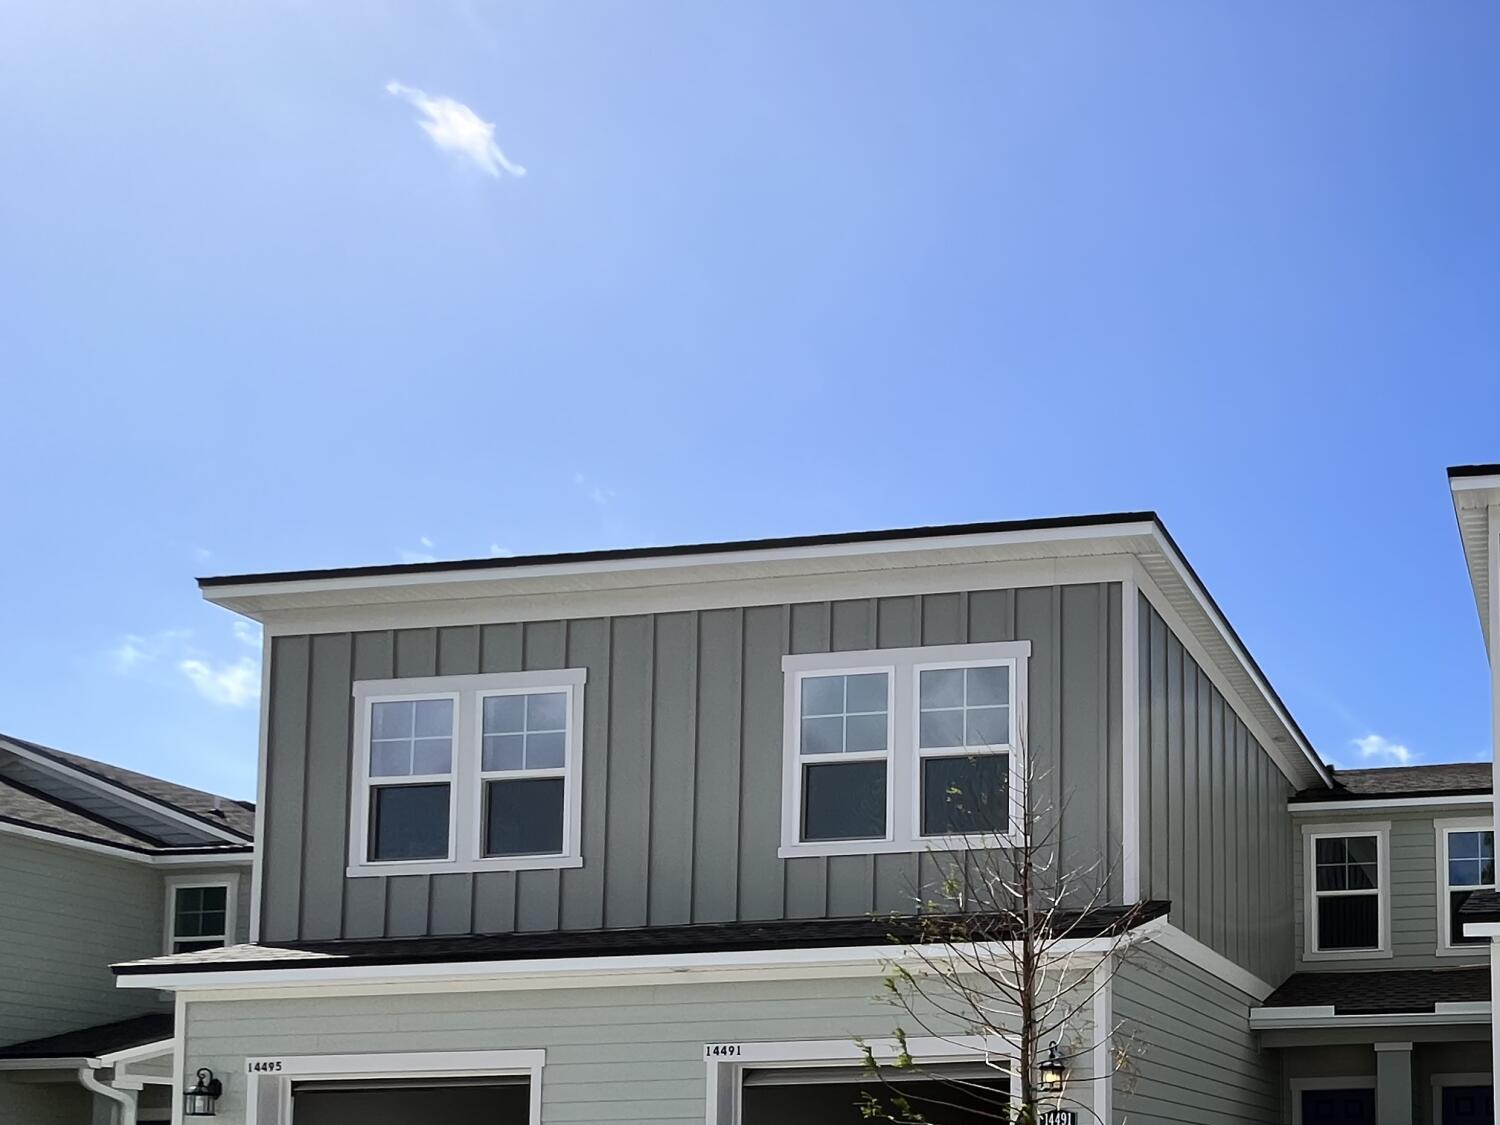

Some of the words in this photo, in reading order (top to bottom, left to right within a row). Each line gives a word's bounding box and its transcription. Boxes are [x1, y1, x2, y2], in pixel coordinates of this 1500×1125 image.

[706, 1045, 741, 1056] 14491
[248, 1061, 282, 1072] 14495
[1044, 1112, 1071, 1125] 14491
